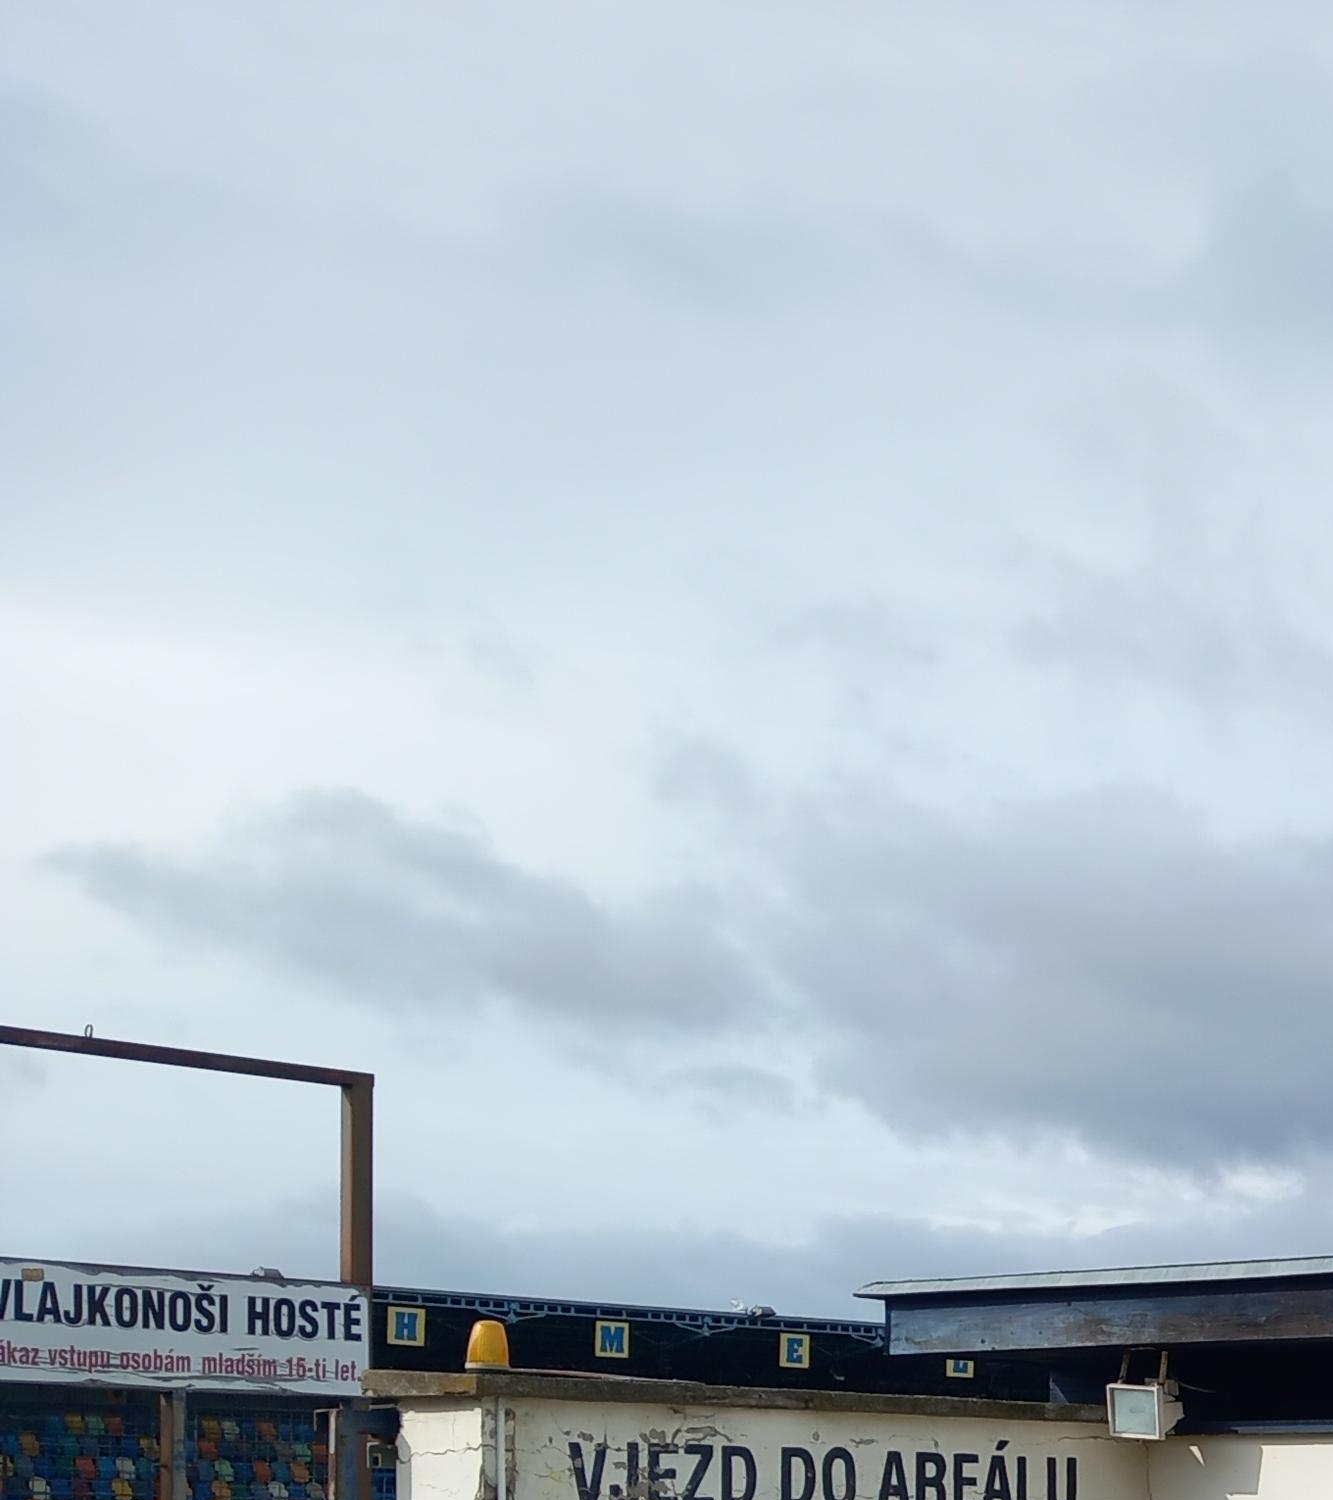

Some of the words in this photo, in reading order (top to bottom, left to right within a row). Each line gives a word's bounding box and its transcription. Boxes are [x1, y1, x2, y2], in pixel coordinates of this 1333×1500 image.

[247, 1294, 362, 1342] HOSTÉ
[394, 1311, 417, 1341] H
[600, 1325, 624, 1353] M
[787, 1338, 803, 1364] E
[48, 1345, 110, 1373] vstupu
[120, 1349, 191, 1373] osobám
[202, 1353, 277, 1377] mladším
